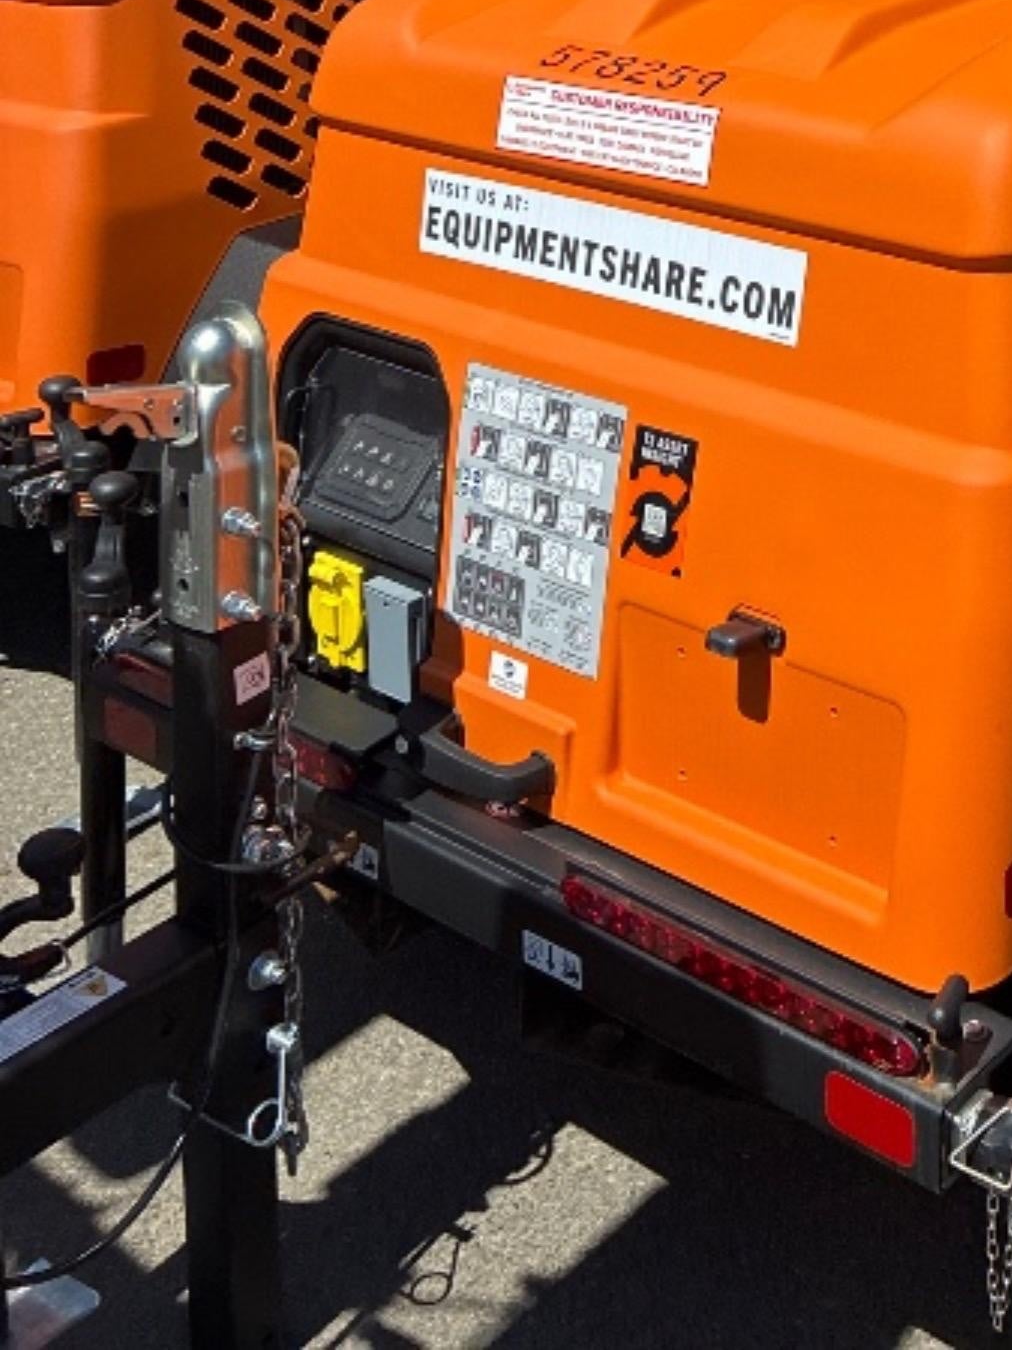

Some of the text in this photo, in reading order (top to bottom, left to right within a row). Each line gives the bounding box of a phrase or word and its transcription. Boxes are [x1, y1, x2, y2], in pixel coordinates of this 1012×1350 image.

[539, 43, 728, 97] 578259
[429, 177, 530, 212] VISIT US AT:
[424, 204, 799, 331] EQUIPMENTSHARE.COM
